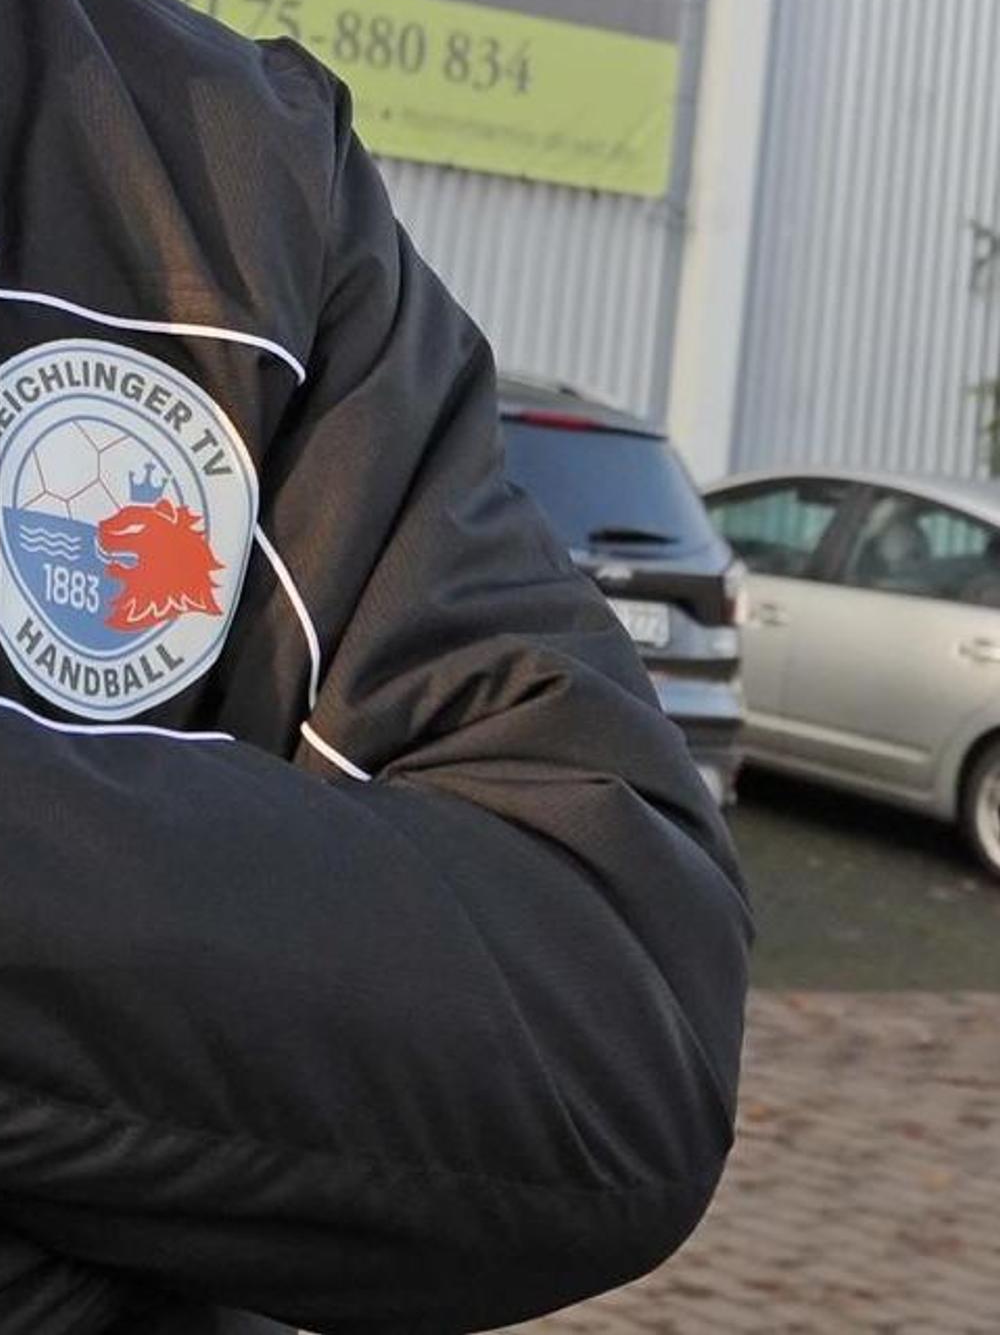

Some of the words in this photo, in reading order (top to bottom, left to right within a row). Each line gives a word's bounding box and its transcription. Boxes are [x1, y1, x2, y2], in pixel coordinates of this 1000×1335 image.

[443, 28, 533, 96] 834
[190, 428, 233, 476] TV
[42, 563, 99, 615] 1883
[15, 616, 185, 699] HANDBALL
